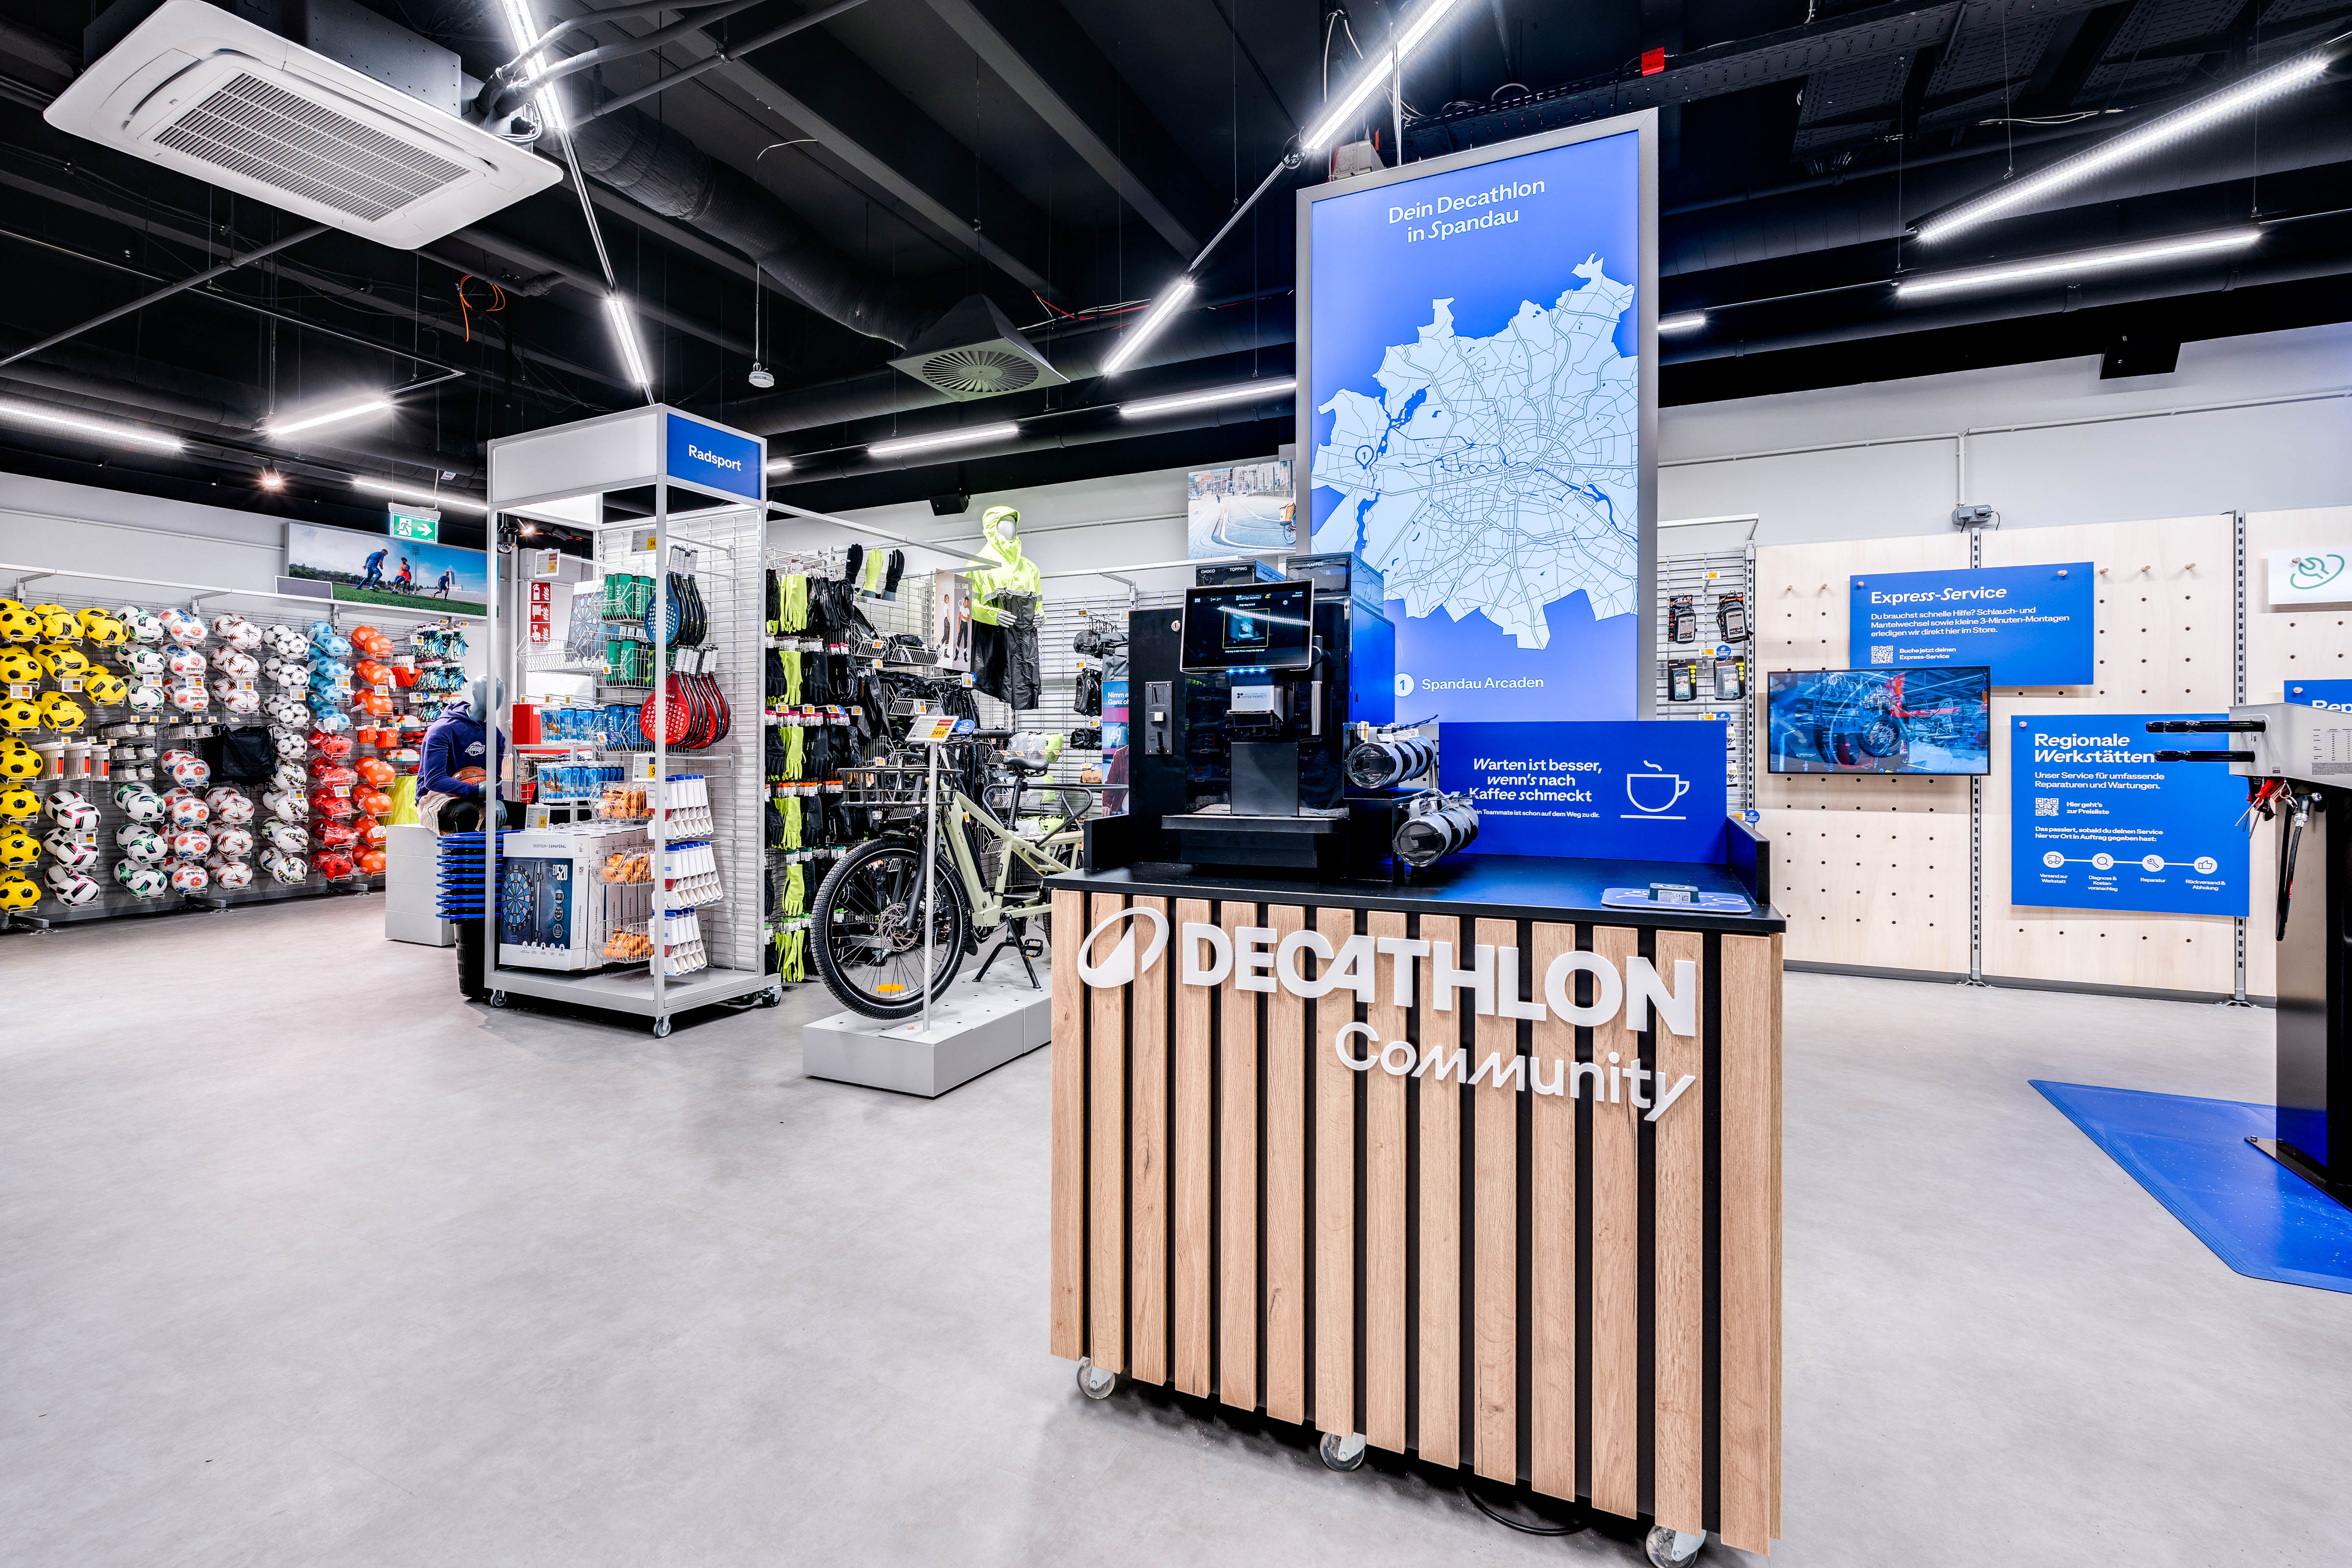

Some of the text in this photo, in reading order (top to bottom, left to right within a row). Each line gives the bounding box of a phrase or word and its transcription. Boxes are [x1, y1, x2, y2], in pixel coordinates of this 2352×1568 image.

[1389, 180, 1545, 224] Dein Decathlon
[1407, 209, 1519, 243] in Spandau
[688, 444, 741, 471] Radsport
[1871, 586, 2007, 606] Express-Service
[1883, 611, 1918, 619] brauchst
[1977, 608, 2018, 616] Schlauch-
[1980, 614, 2070, 624] 3-Minuten-Montagen
[352, 635, 364, 646] KIPSTA
[1871, 629, 1907, 637] erledigen
[1399, 679, 1405, 690] 1
[1421, 676, 1544, 692] Spandau Arcaden
[2034, 733, 2131, 750] Regionale
[2034, 749, 2156, 763] Werkstätten
[1473, 758, 1602, 774] Warten ist besser,
[1487, 773, 1575, 786] wenn's nach
[2034, 781, 2089, 789] Reparaturen
[2107, 782, 2160, 790] Wartungen.
[1469, 787, 1592, 803] Kaffee schmeckt
[1182, 922, 1696, 1037] DECATHLON
[1335, 1021, 1696, 1122] Community
